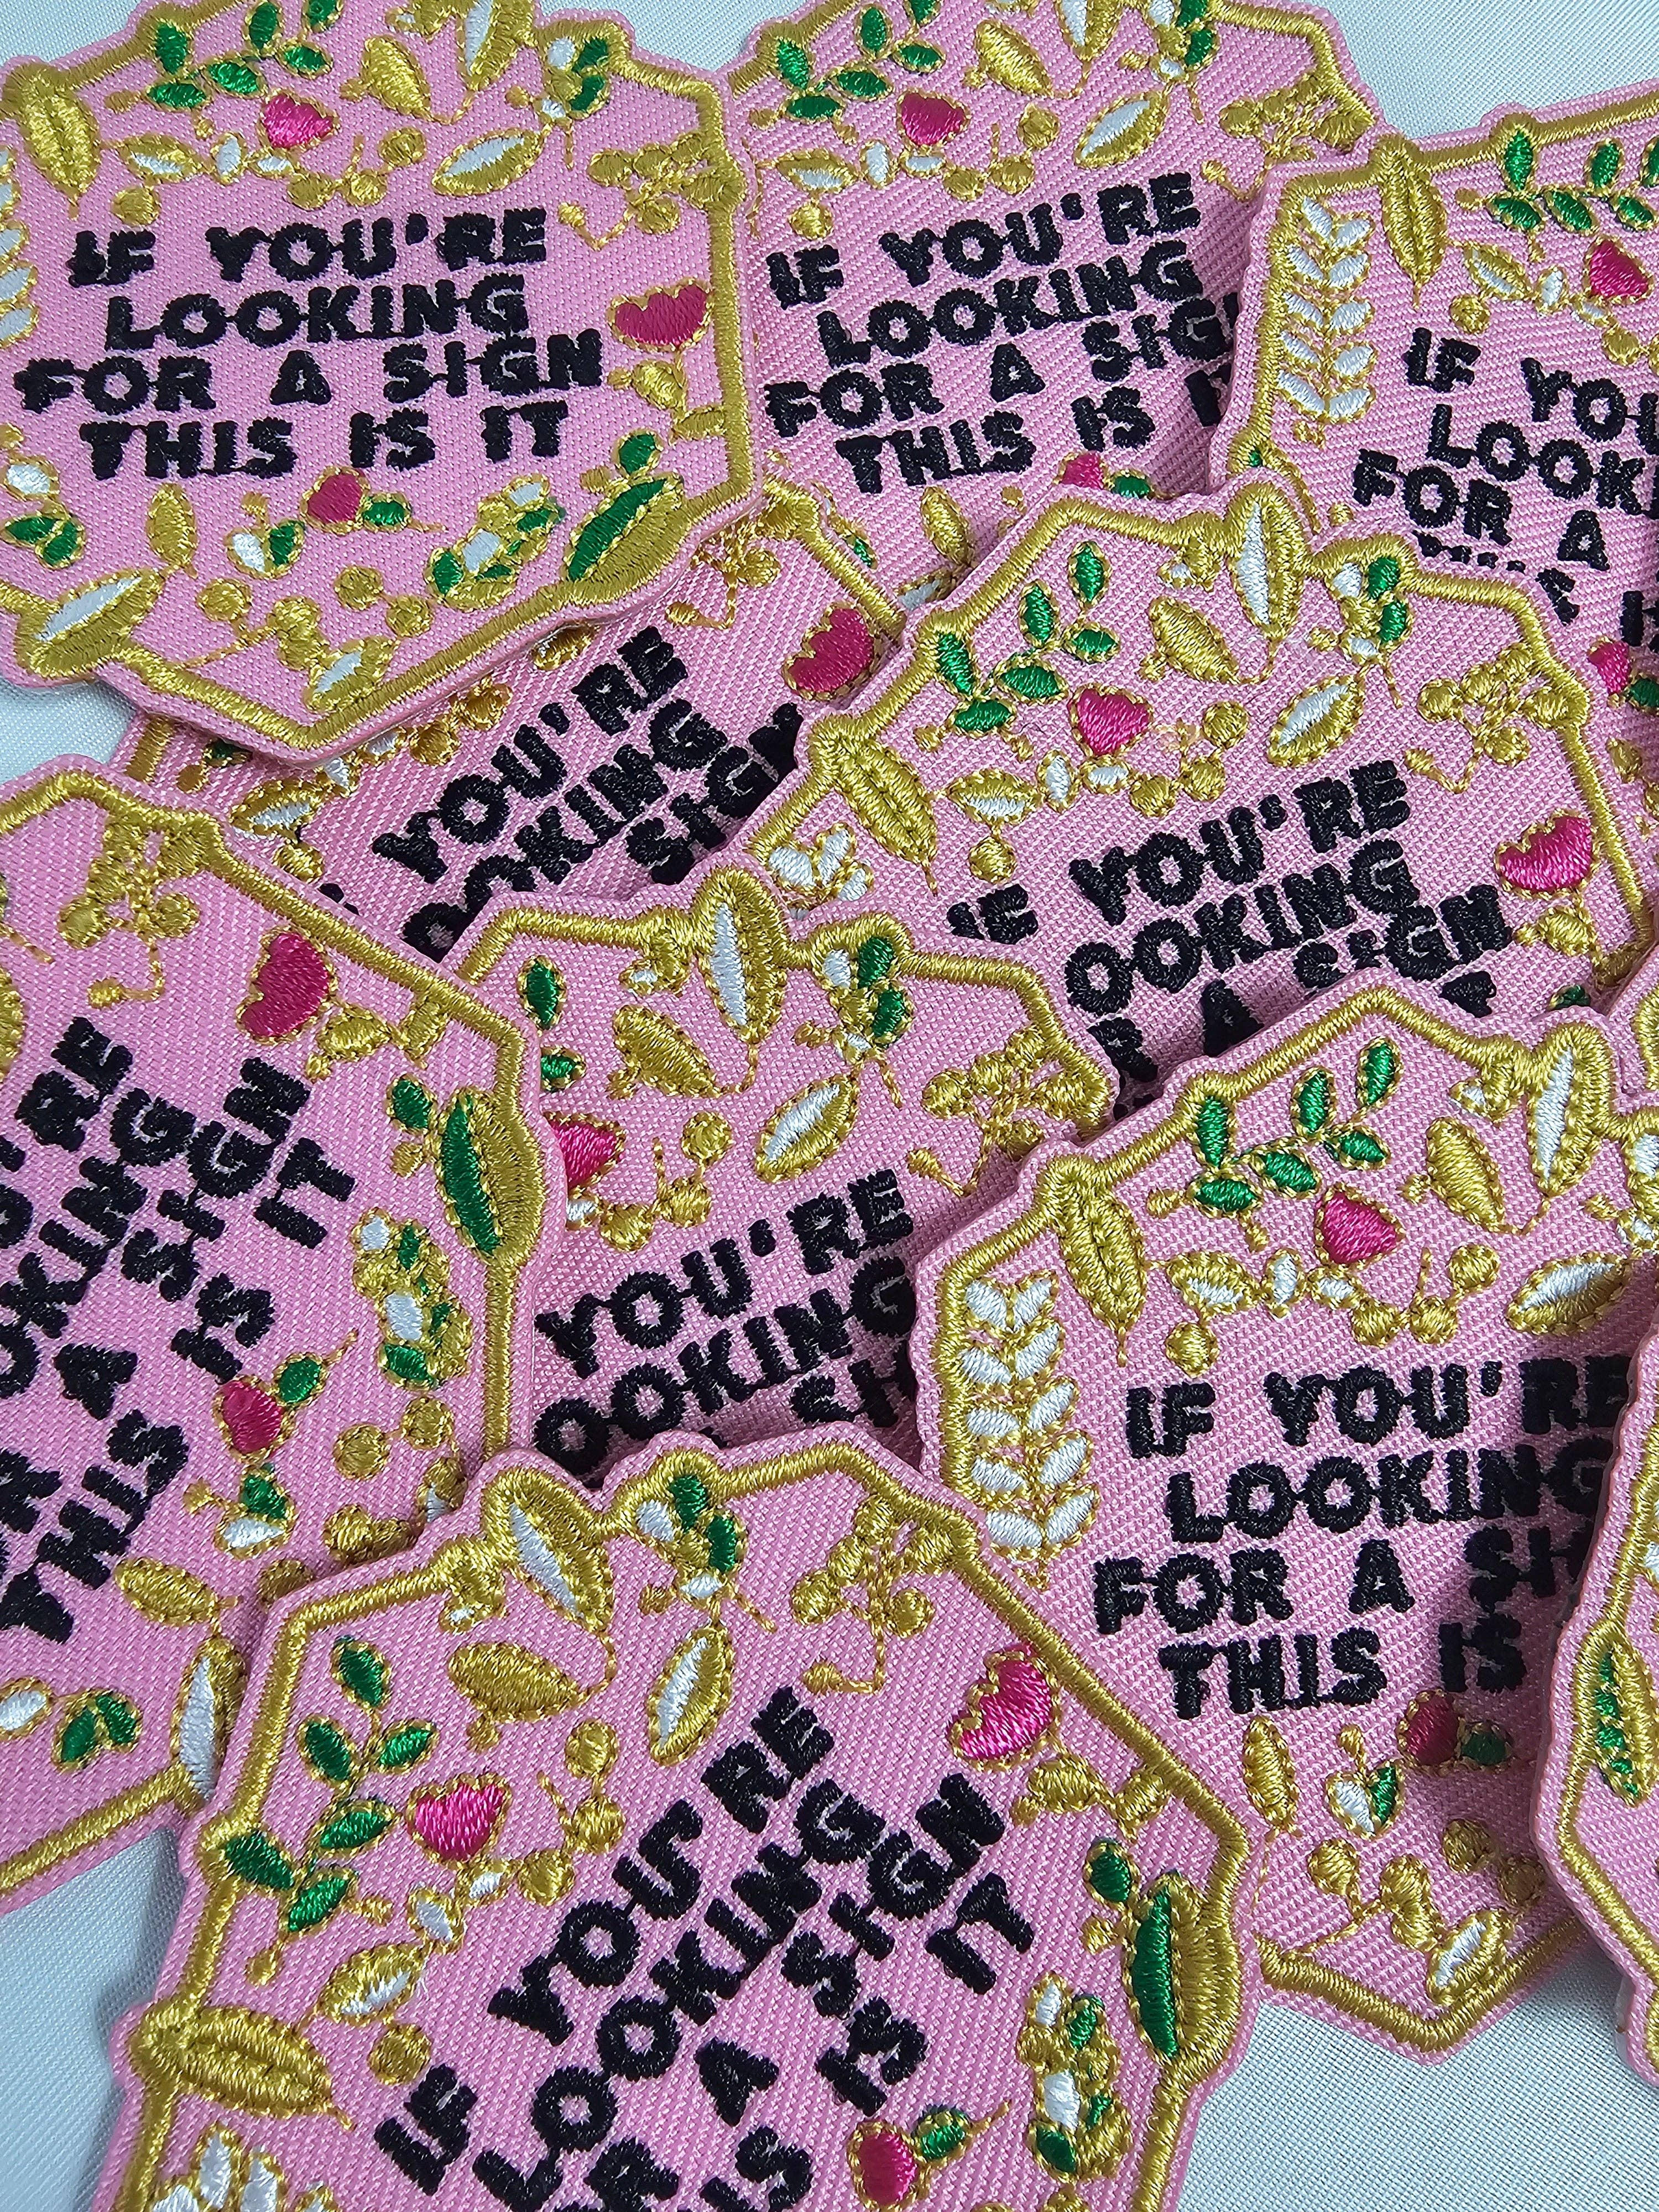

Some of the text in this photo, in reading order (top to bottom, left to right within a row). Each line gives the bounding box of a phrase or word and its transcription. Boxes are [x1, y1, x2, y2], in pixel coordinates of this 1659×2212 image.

[69, 207, 547, 288] IF YOU'RE
[765, 171, 1202, 311] IF YOU'RE
[105, 273, 530, 351] LOOKING
[816, 239, 1204, 368] LOOKING
[1402, 326, 1482, 394] IF
[13, 327, 604, 415] FOR A SIGN
[763, 360, 945, 439] FOR
[990, 342, 1047, 403] A
[79, 399, 568, 481] THIS IS IT
[834, 410, 1037, 495] THIS
[1070, 385, 1157, 452] IS
[1426, 403, 1659, 520] LOOK
[1352, 448, 1611, 572] FOR A
[372, 624, 690, 885] YOU'RE
[1068, 758, 1411, 926] YOU'RE
[1199, 978, 1264, 1058] A
[54, 1056, 311, 1421] A SIGN
[535, 1168, 914, 1380] YOU'RE
[0, 1407, 189, 1644] THIS
[170, 1271, 276, 1384] IS
[254, 1136, 356, 1249] IT
[790, 1338, 917, 1429] SI
[1125, 1381, 1217, 1459] IF
[1165, 1436, 1618, 1544] LOOKING
[1093, 1547, 1295, 1635] FOR
[1348, 1538, 1415, 1615] A
[1159, 1610, 1527, 1720] THIS IS
[375, 2064, 477, 2196] IF
[487, 1686, 835, 2048] YOU'RE
[472, 1777, 886, 2212] LOOKING
[694, 1772, 1006, 2127] A SIGN
[814, 1995, 929, 2118] IS
[924, 1872, 1035, 1994] IT
